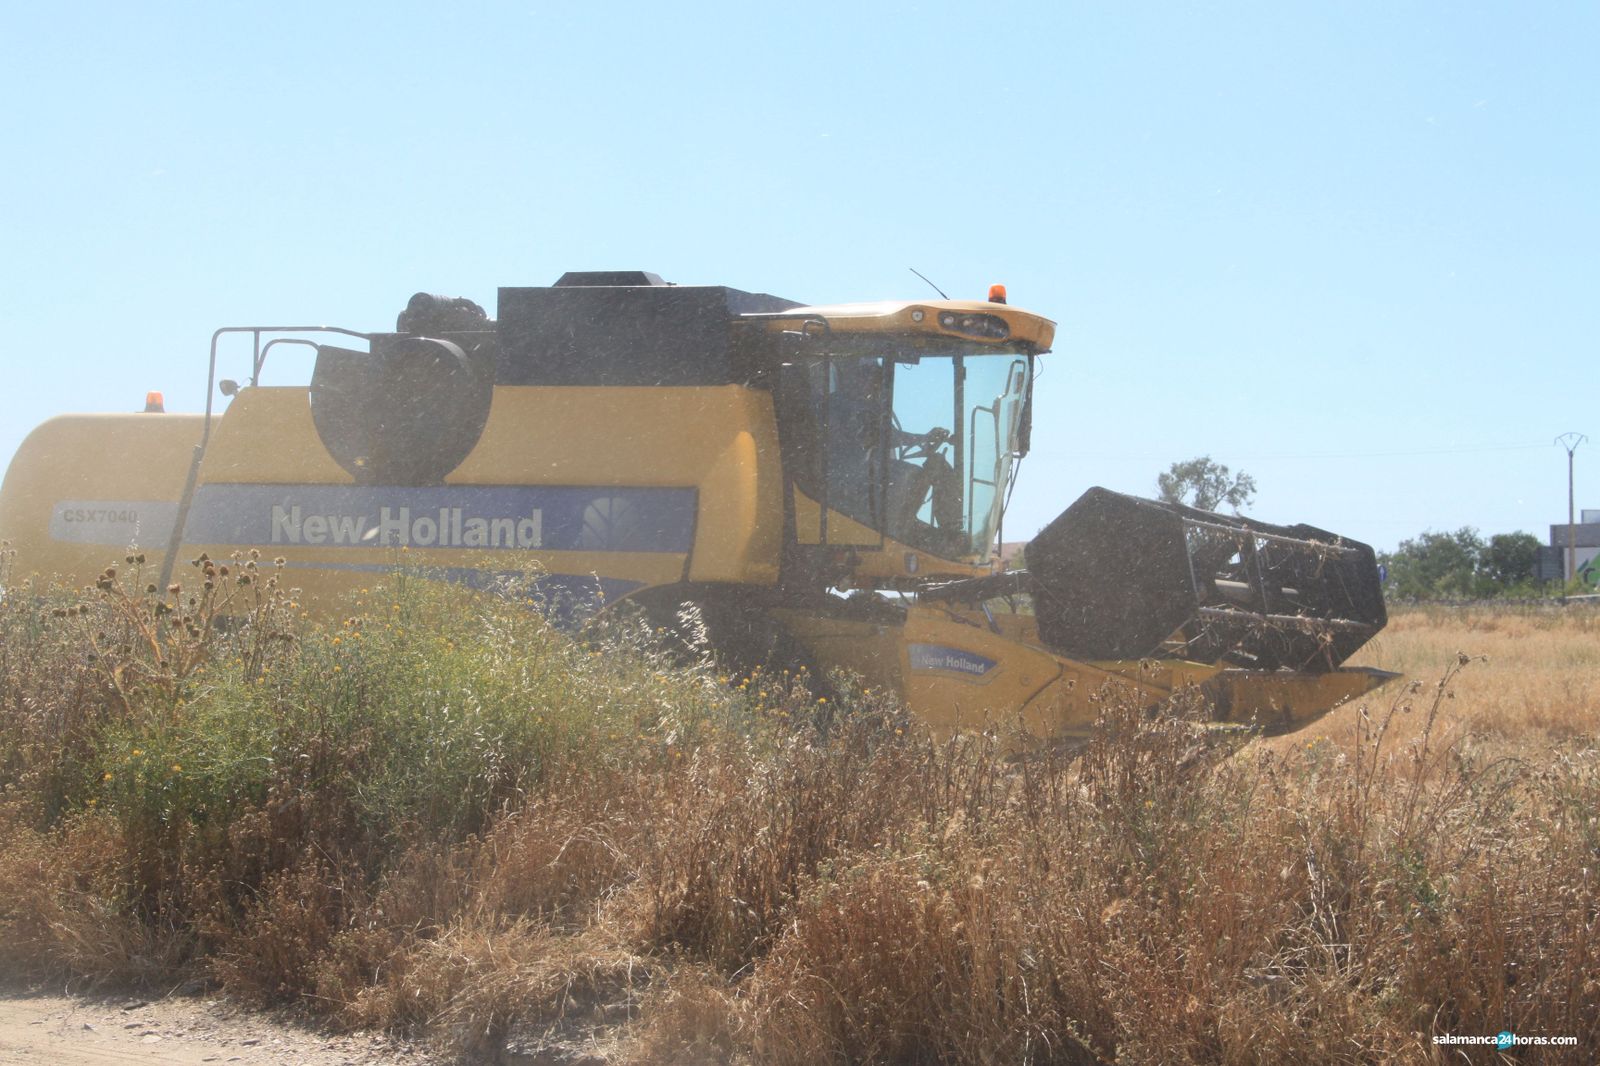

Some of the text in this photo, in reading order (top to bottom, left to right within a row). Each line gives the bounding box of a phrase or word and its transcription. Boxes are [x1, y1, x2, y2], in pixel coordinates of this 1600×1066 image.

[63, 509, 138, 523] CSX7040
[271, 505, 543, 549] New Holland
[921, 654, 985, 673] New Holland
